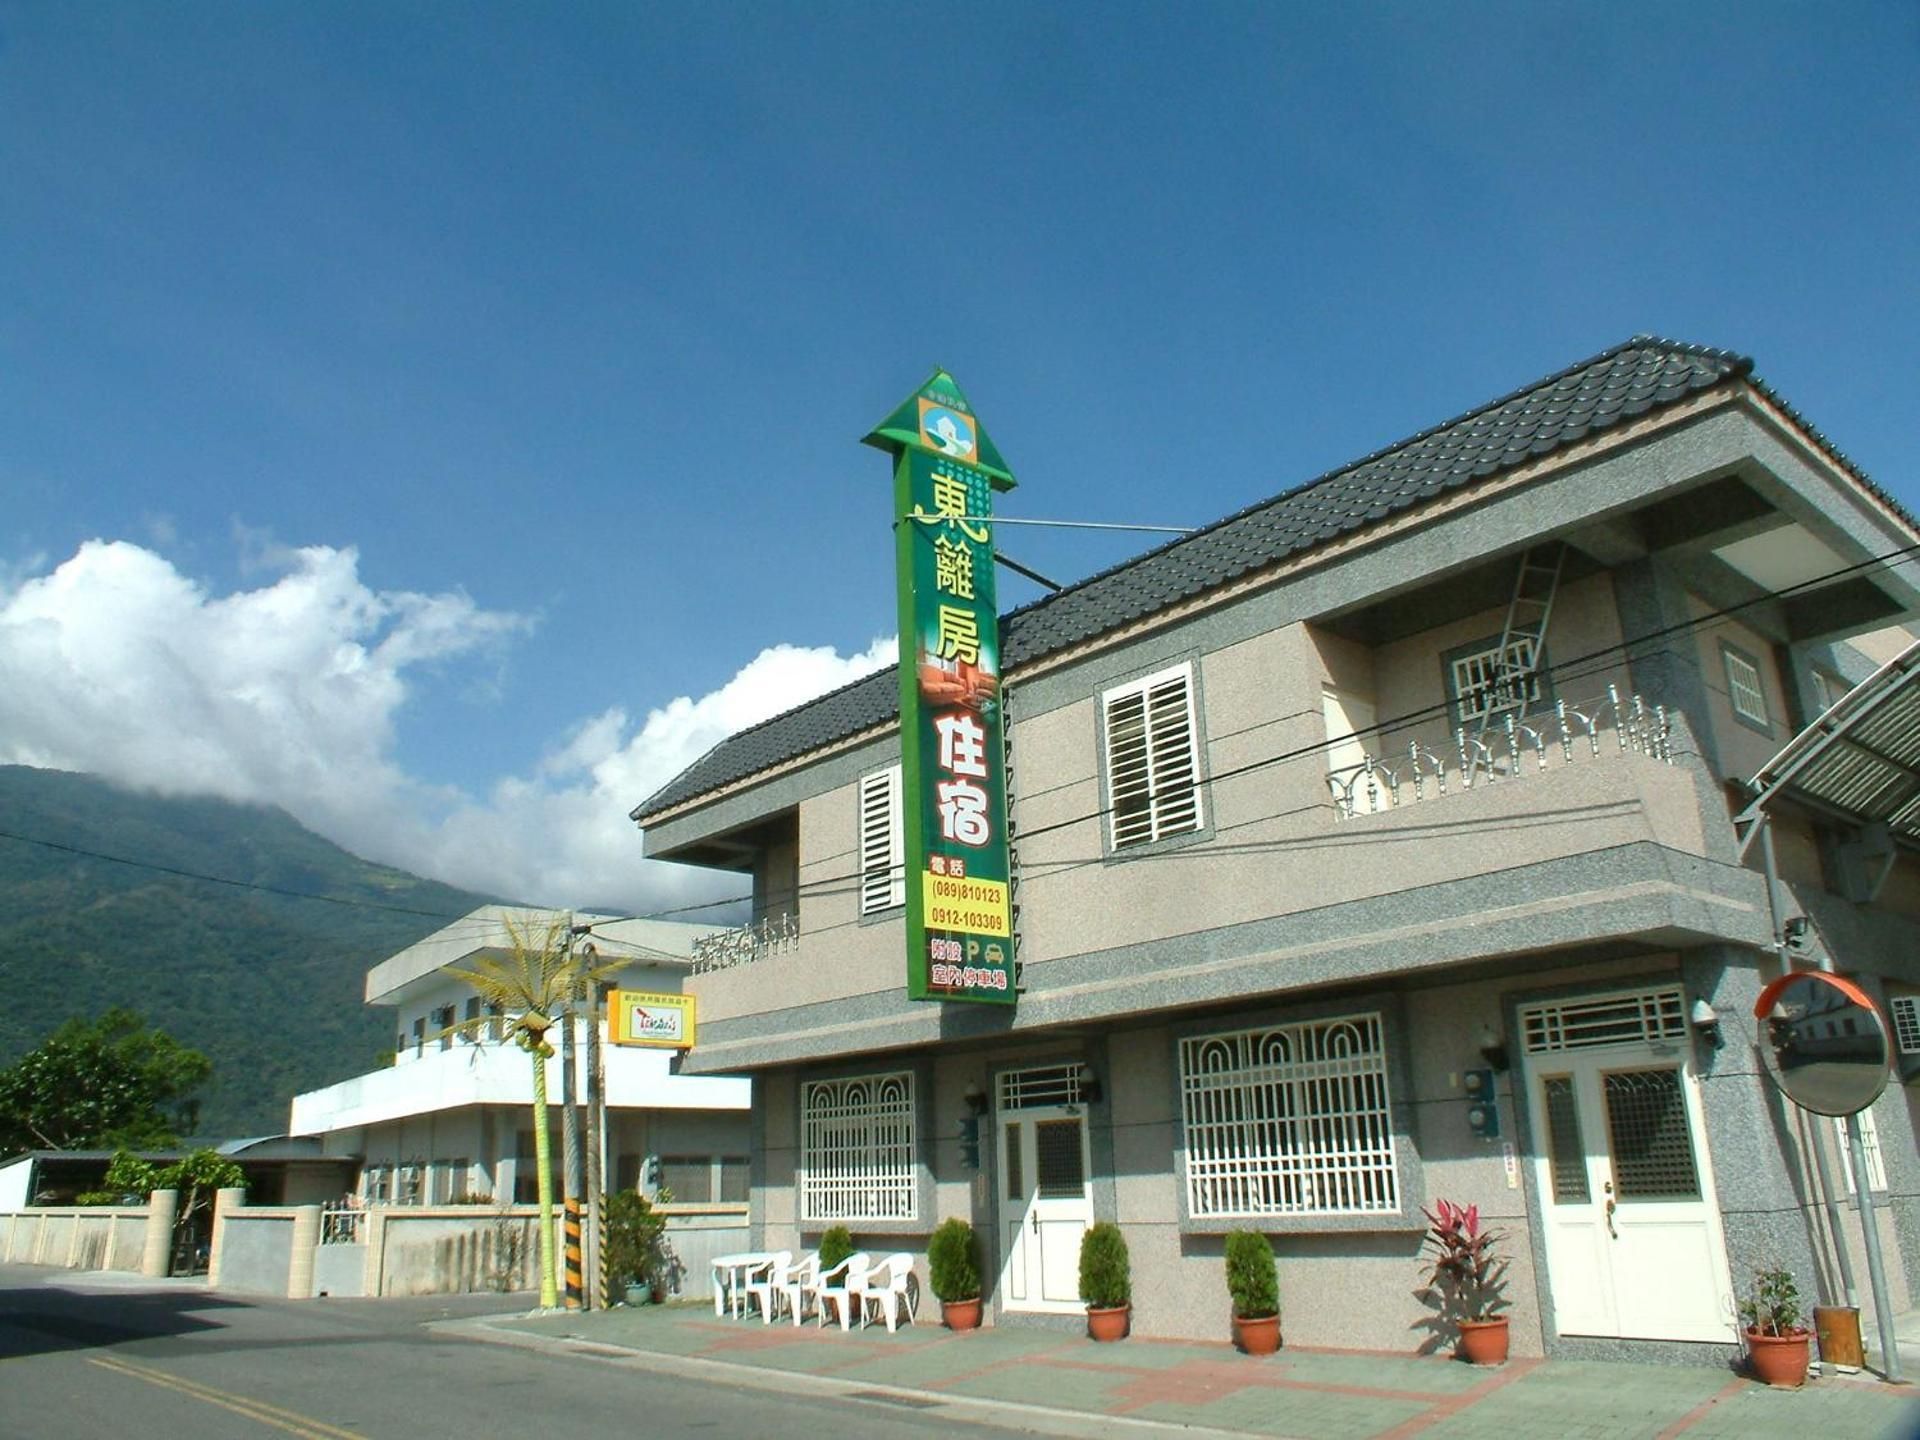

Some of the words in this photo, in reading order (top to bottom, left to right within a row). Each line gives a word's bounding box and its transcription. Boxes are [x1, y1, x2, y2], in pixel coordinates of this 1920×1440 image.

[936, 715, 989, 845] 住宿
[931, 855, 964, 876] 電話
[932, 880, 1001, 904] (089)810123
[932, 907, 1002, 930] 0912-103309
[931, 939, 962, 962] 附設
[931, 963, 1008, 990] 室內停車場
